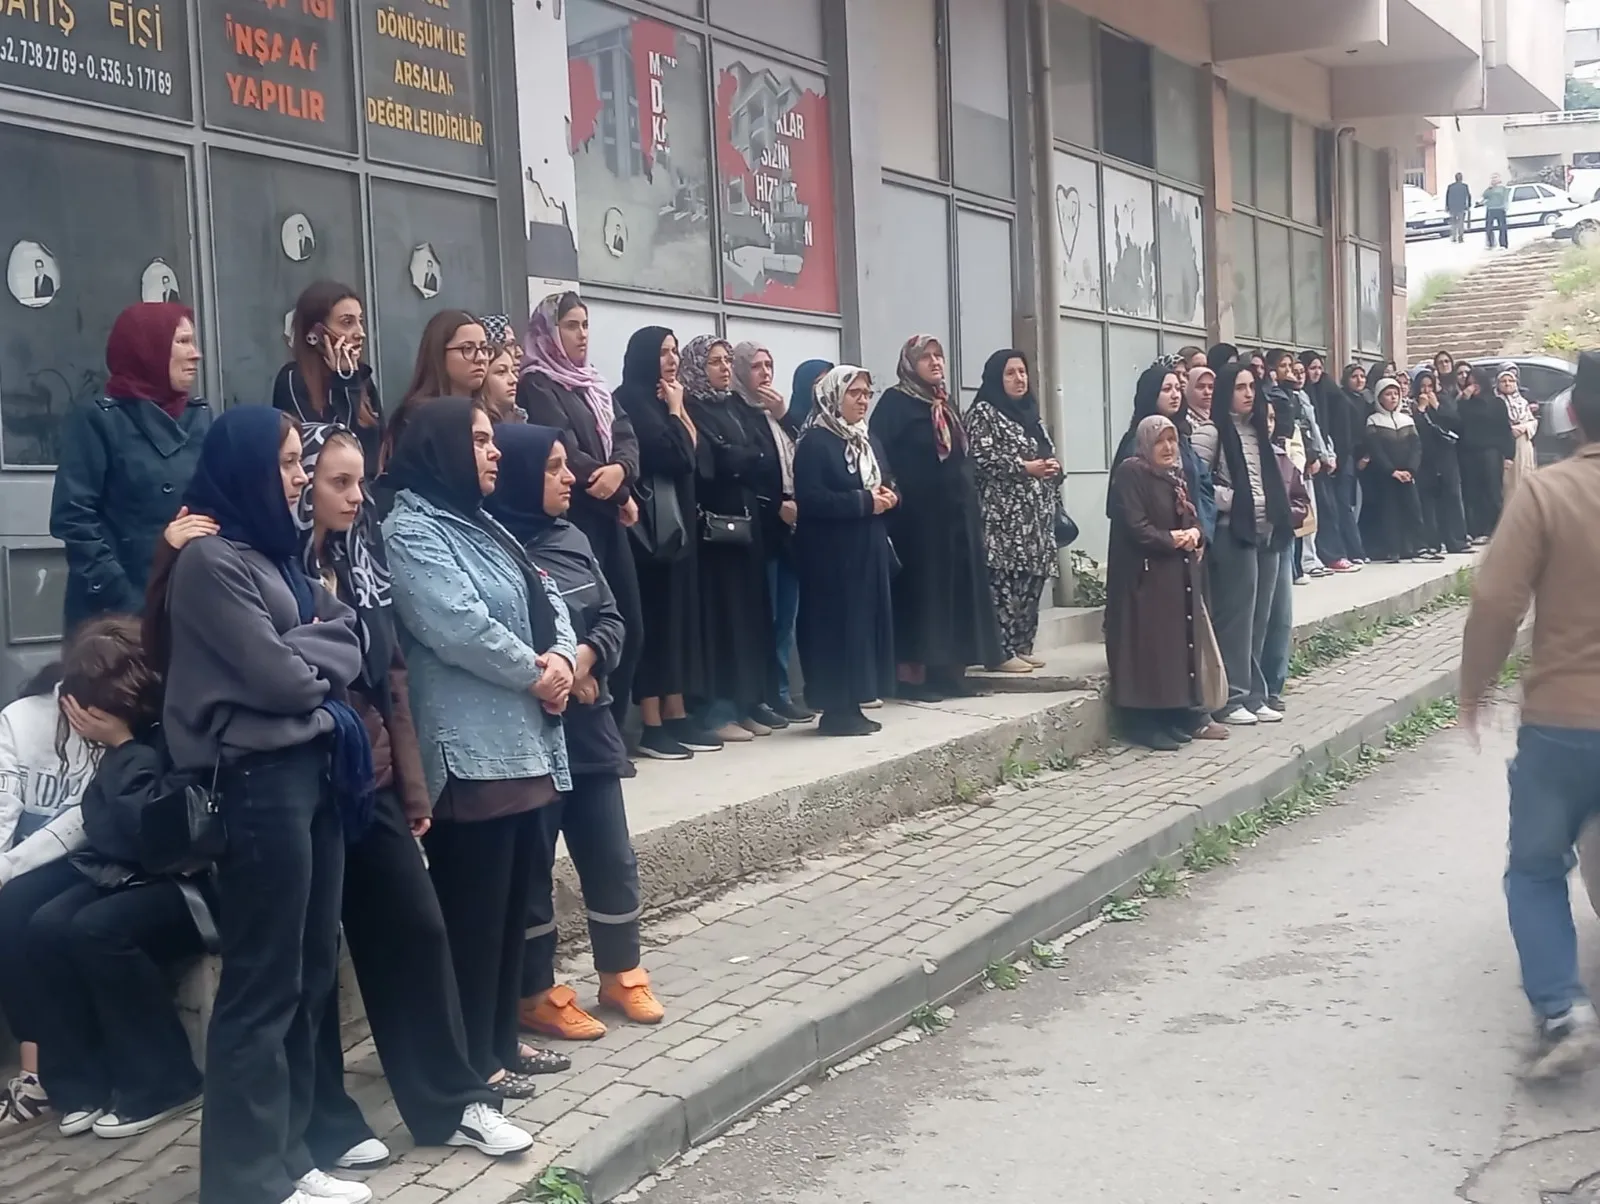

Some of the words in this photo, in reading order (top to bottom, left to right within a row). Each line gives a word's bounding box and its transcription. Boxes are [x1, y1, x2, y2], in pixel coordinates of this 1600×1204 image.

[377, 6, 444, 51] DÖNÜŞÜM
[446, 22, 467, 56] İLE
[225, 71, 325, 122] YAPILIR
